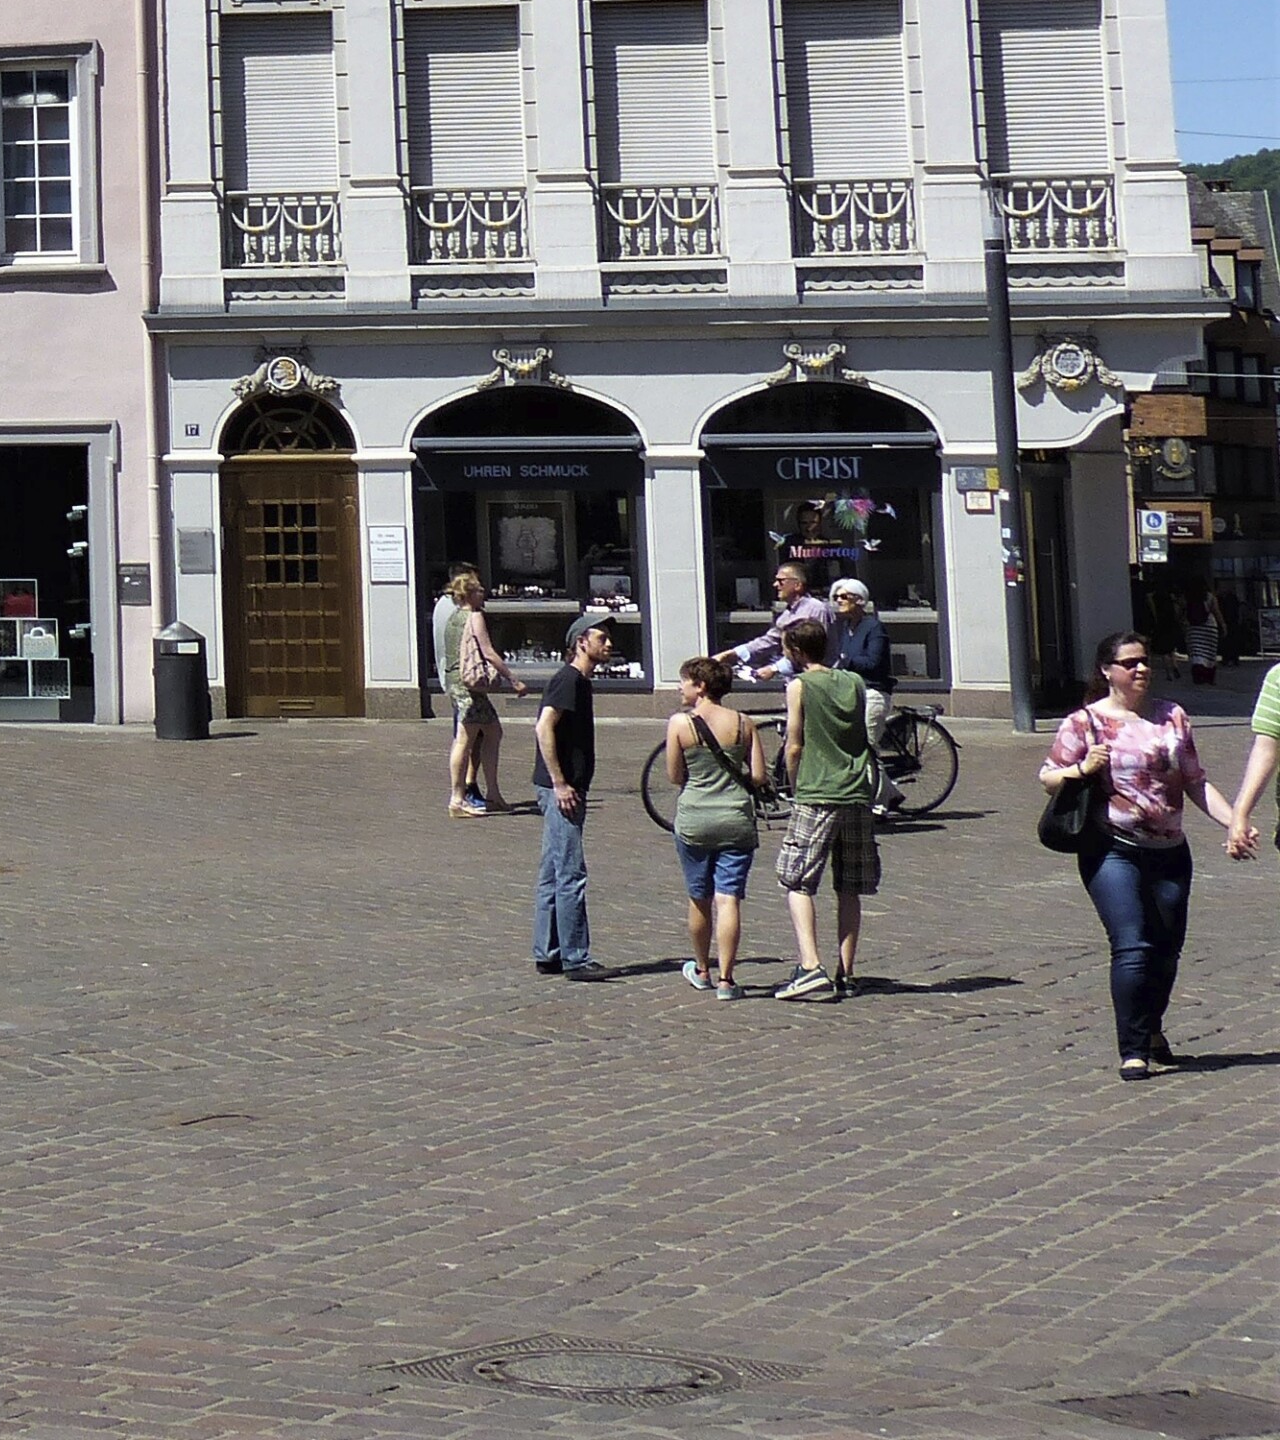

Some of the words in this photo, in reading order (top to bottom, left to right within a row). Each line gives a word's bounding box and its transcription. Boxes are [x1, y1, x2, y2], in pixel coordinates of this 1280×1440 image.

[464, 464, 511, 477] UHREN
[520, 464, 589, 477] SCHMUCK
[776, 456, 862, 480] CHRIST
[789, 545, 860, 560] Muttertag
